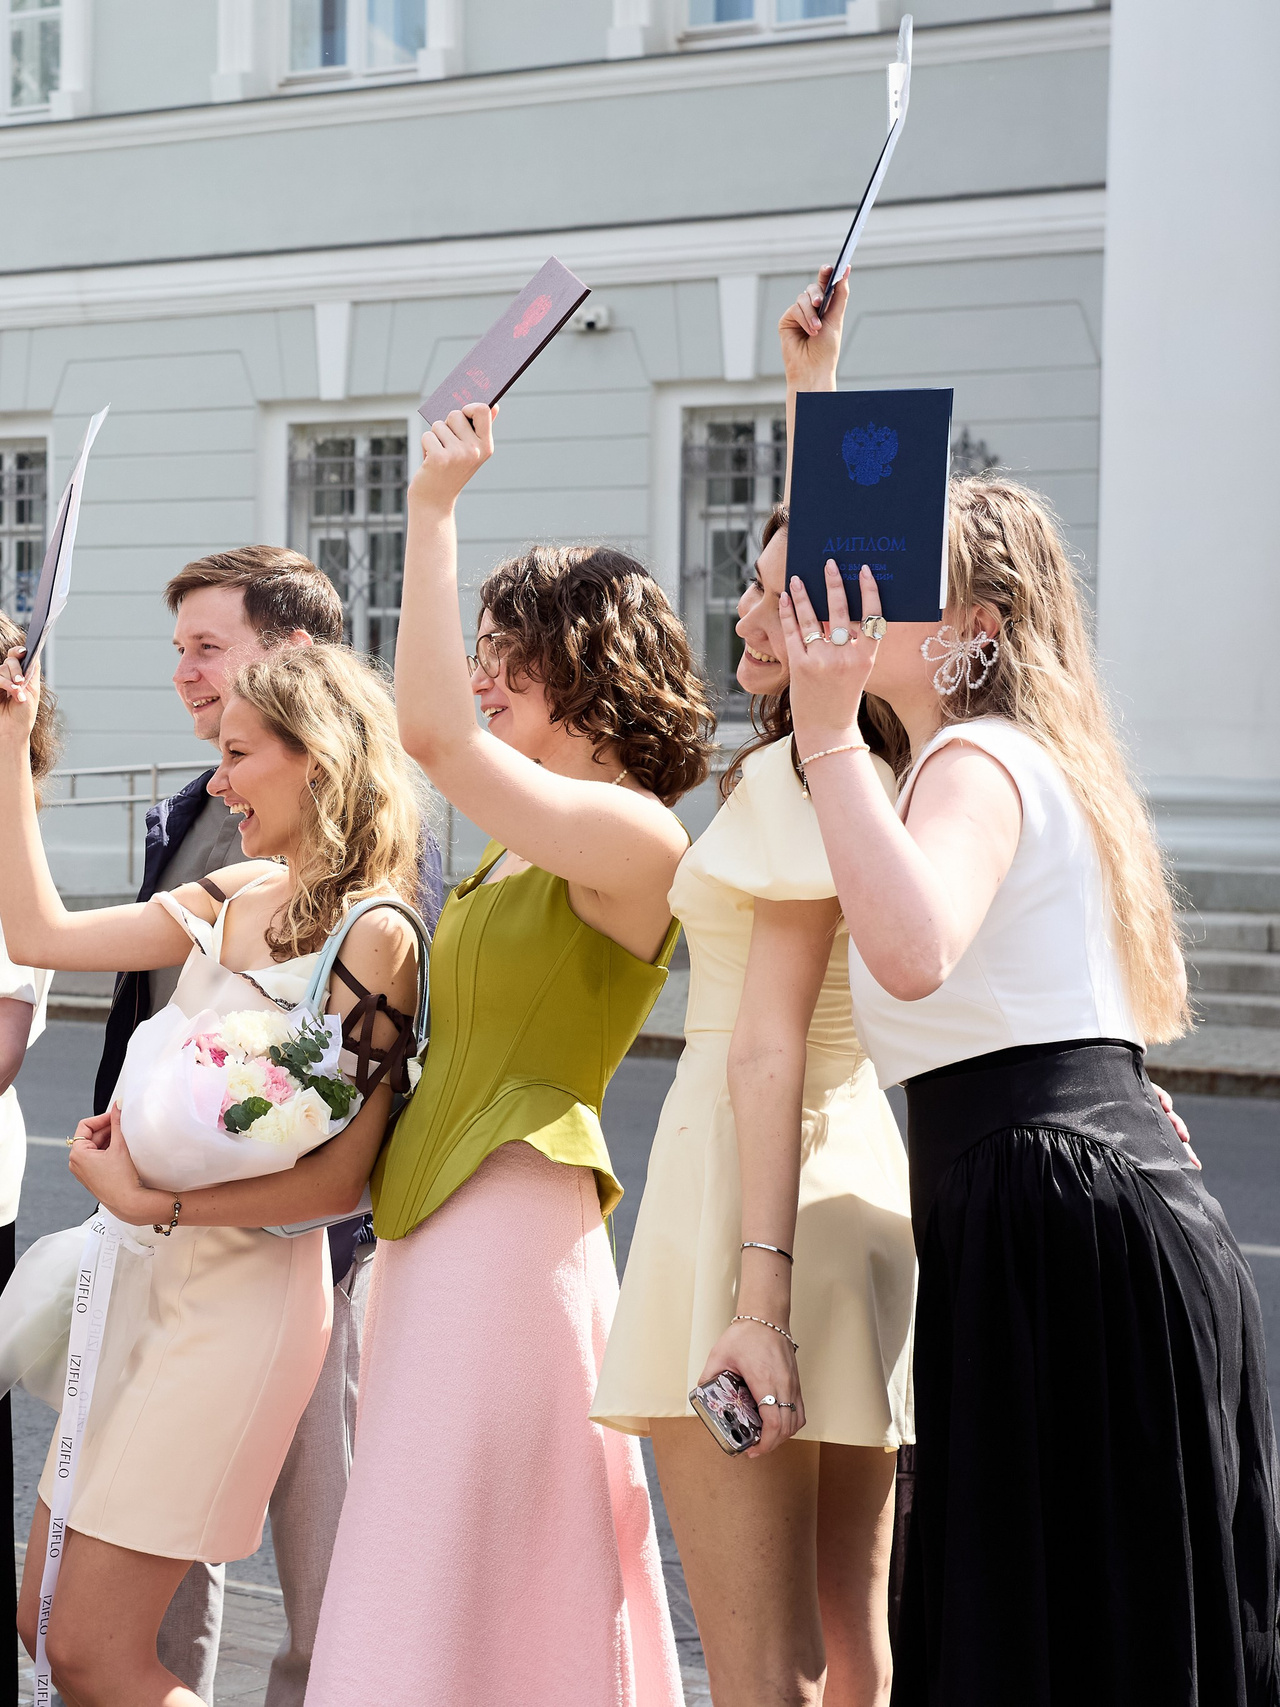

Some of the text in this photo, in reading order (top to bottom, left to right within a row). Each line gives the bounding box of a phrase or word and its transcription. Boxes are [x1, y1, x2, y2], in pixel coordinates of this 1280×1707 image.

[822, 536, 907, 554] ДИПЛОМ
[848, 563, 887, 571] ВЫЕМ
[76, 1269, 92, 1314] IZIFLO
[67, 1354, 82, 1397] IZIFLO
[58, 1436, 73, 1479] IZIFLO
[49, 1517, 64, 1558] IZIFLO
[39, 1594, 53, 1636] IZIFLO
[37, 1674, 49, 1707] IZIFL
